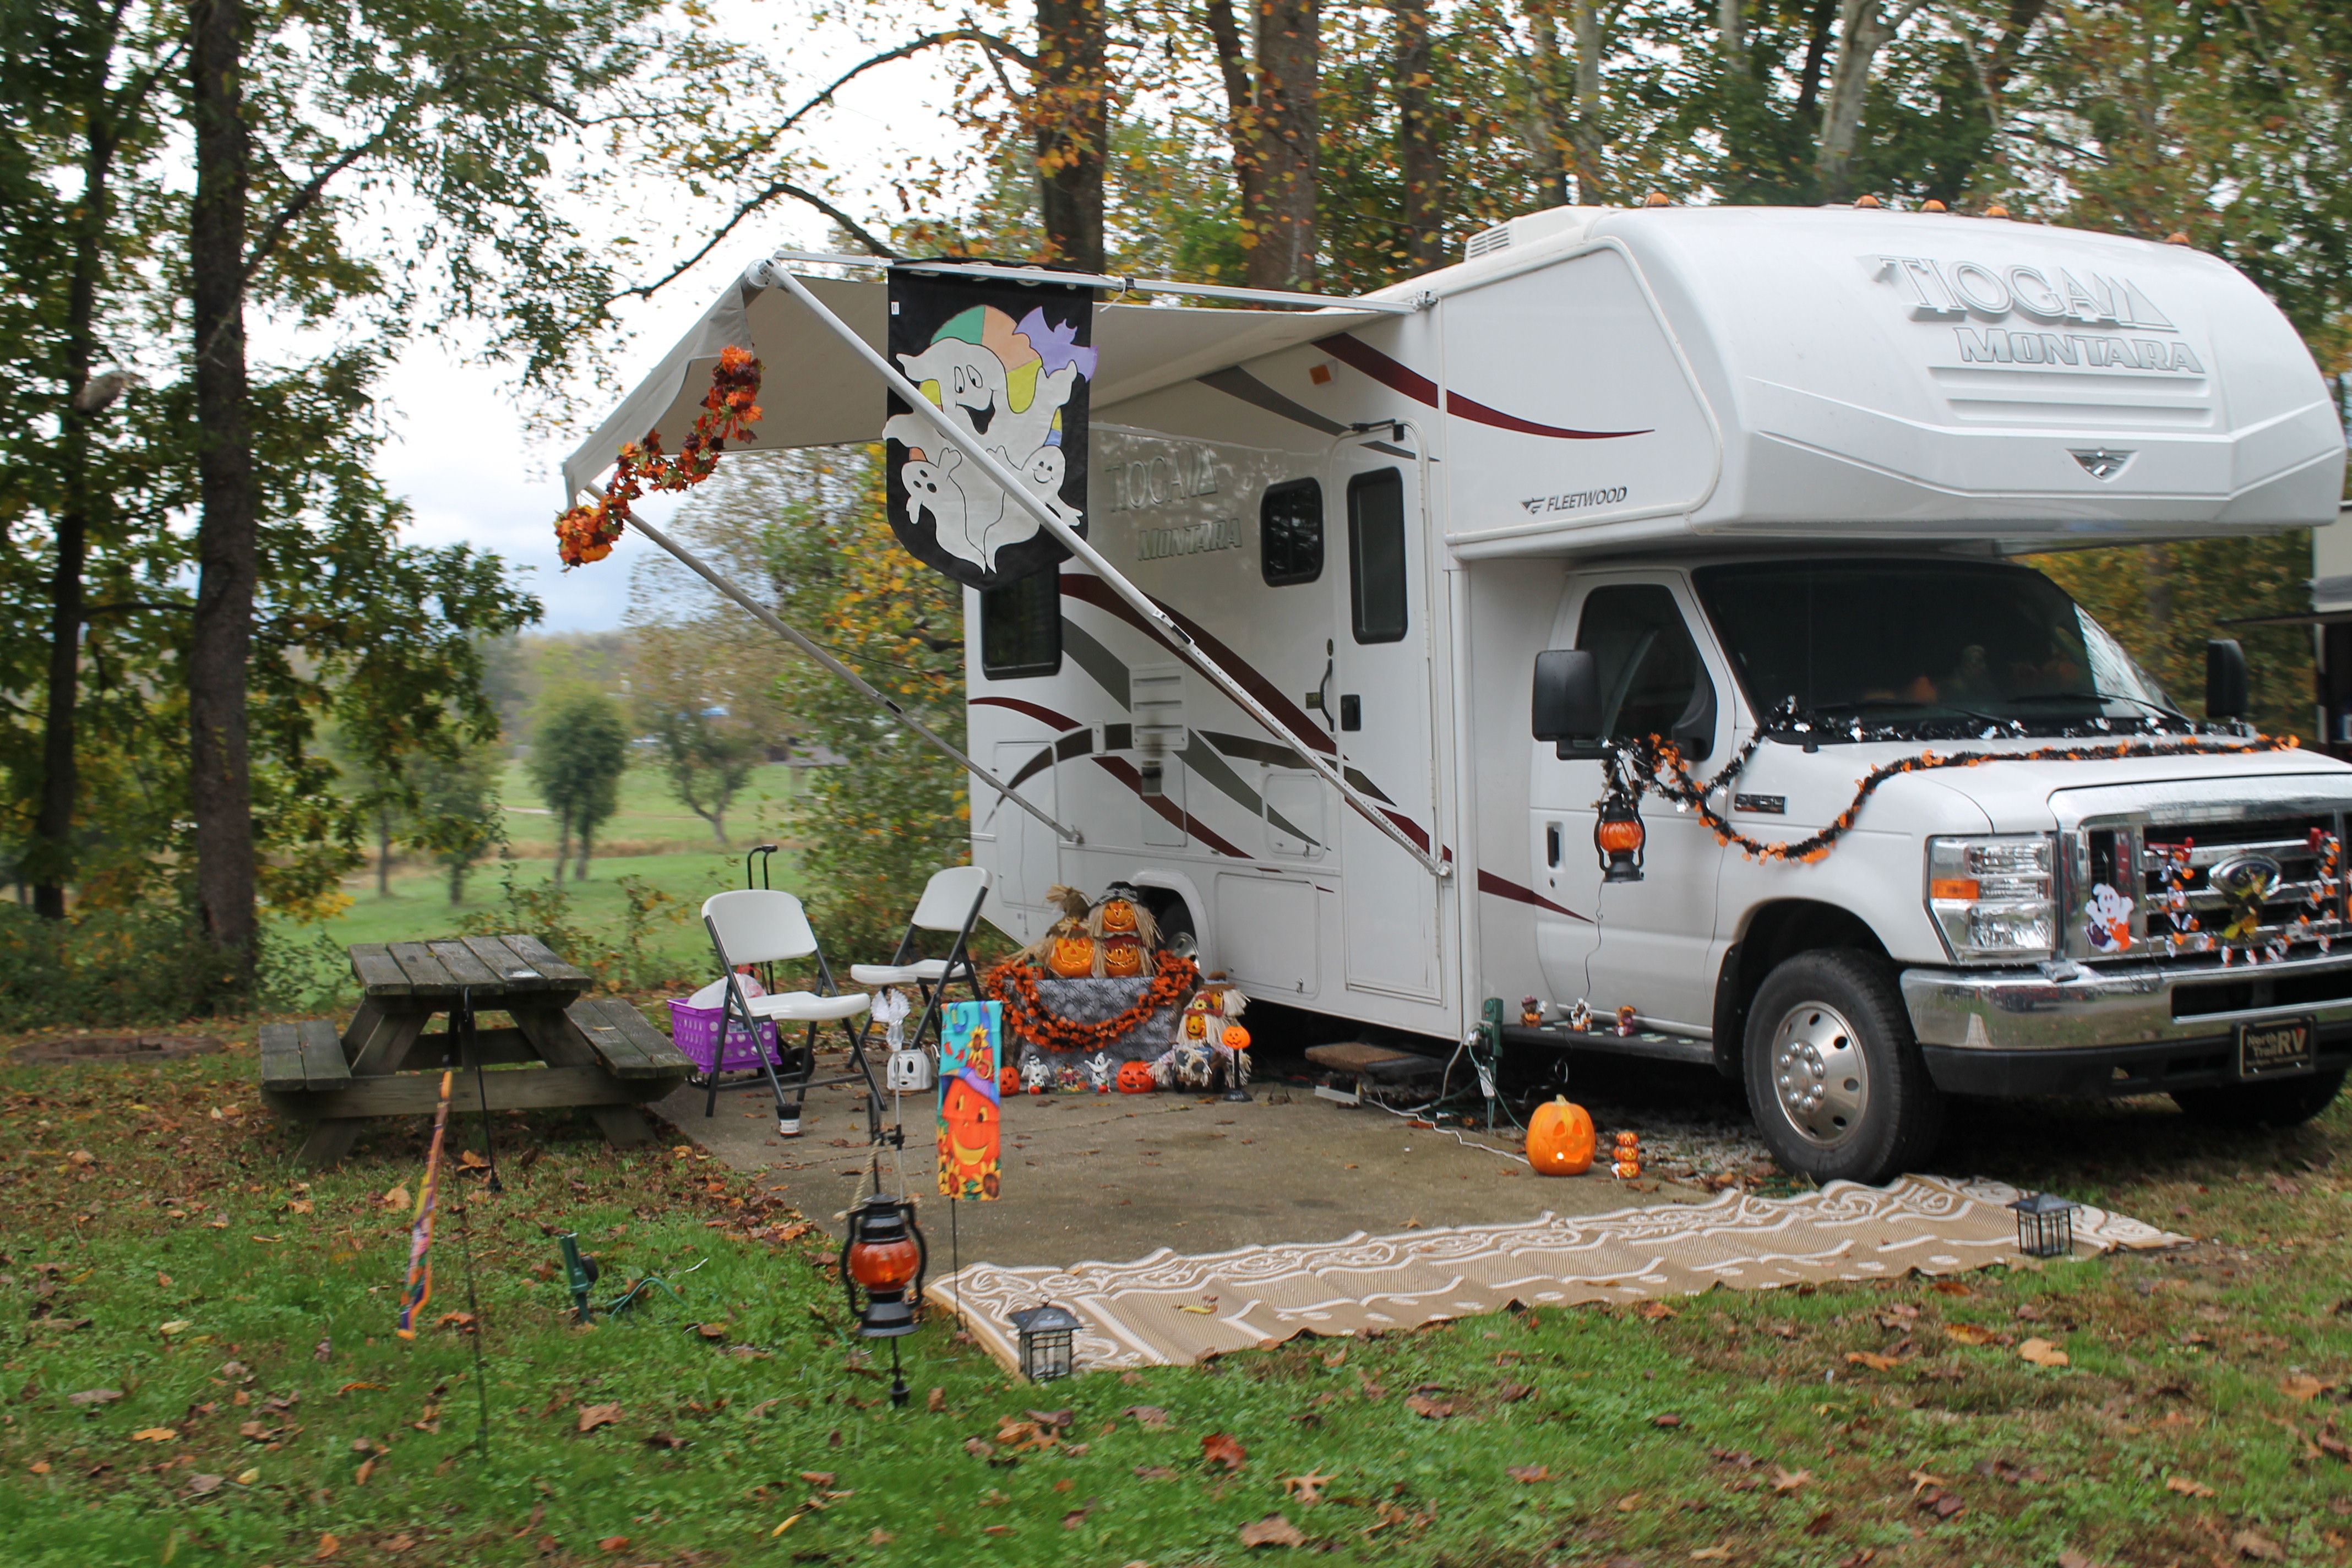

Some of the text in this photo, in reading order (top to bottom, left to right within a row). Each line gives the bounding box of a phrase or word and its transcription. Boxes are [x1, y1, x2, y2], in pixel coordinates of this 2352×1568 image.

[1875, 255, 2123, 324] TIOGA
[1953, 326, 2206, 374] MONTARA
[1547, 486, 1627, 512] FLEETWOOD
[1137, 518, 1242, 560] MONTARA
[2277, 1027, 2307, 1054] RV
